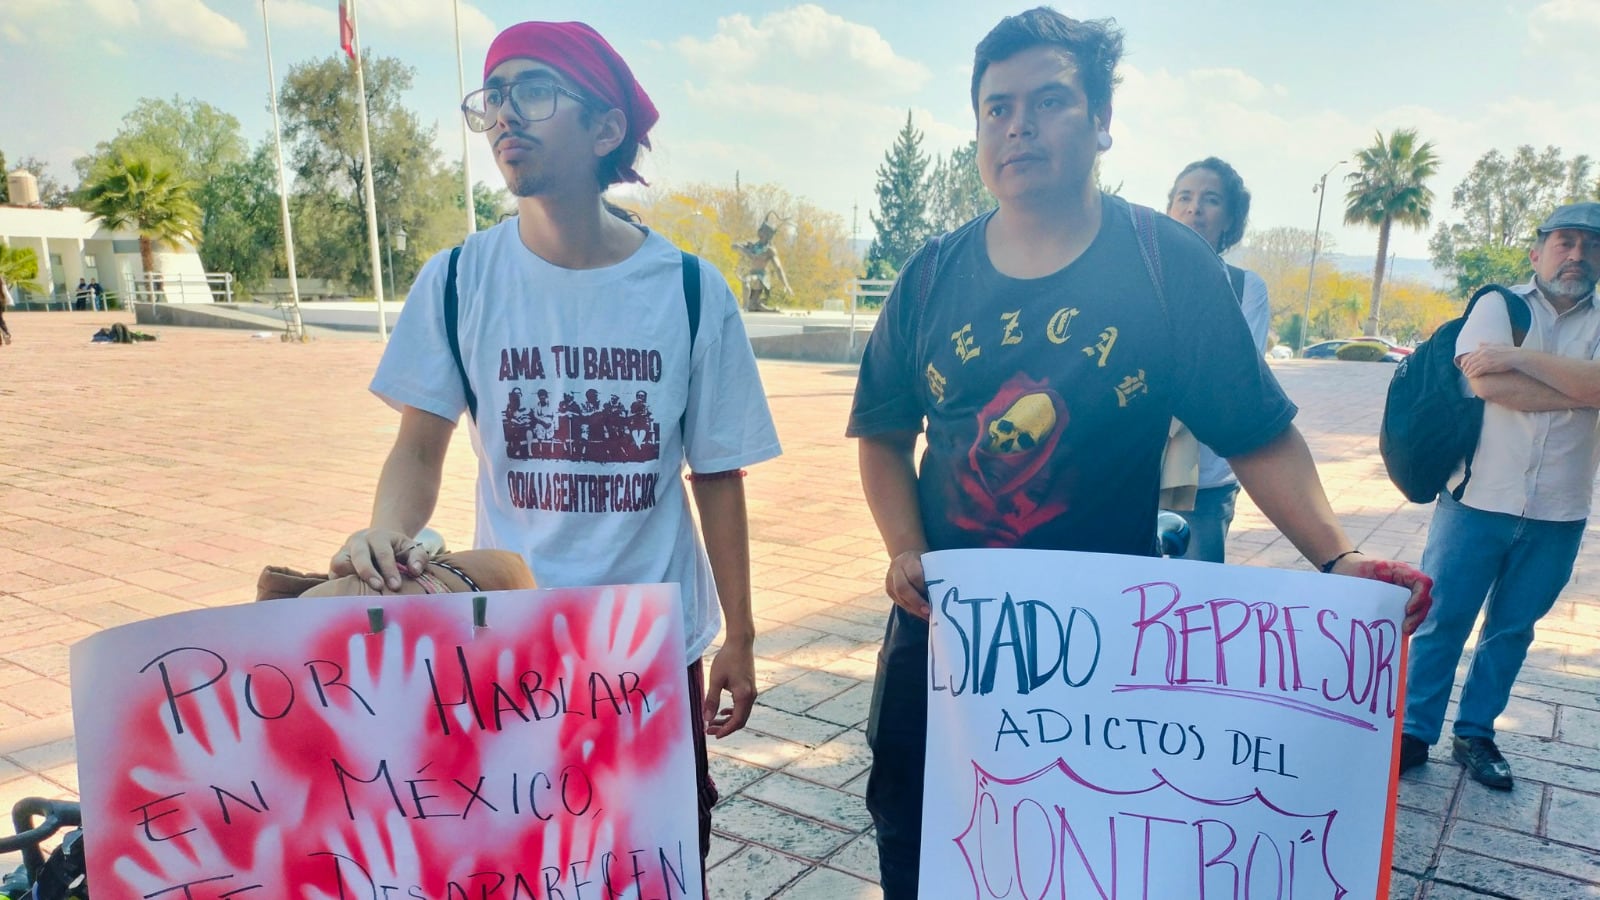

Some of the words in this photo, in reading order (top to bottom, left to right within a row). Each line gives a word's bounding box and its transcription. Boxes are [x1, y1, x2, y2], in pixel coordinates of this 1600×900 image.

[498, 347, 546, 381] AMA
[551, 345, 580, 379] TU
[583, 346, 663, 383] BARRIO
[507, 470, 539, 509] ODIA
[537, 472, 552, 511] LA
[924, 579, 1101, 697] ESTADO
[1121, 581, 1397, 718] REPRESOR
[138, 647, 376, 735] POR
[425, 646, 652, 736] HABLAR
[994, 708, 1205, 761] ADICTOS
[1224, 729, 1299, 779] DEL
[130, 780, 270, 842] EN
